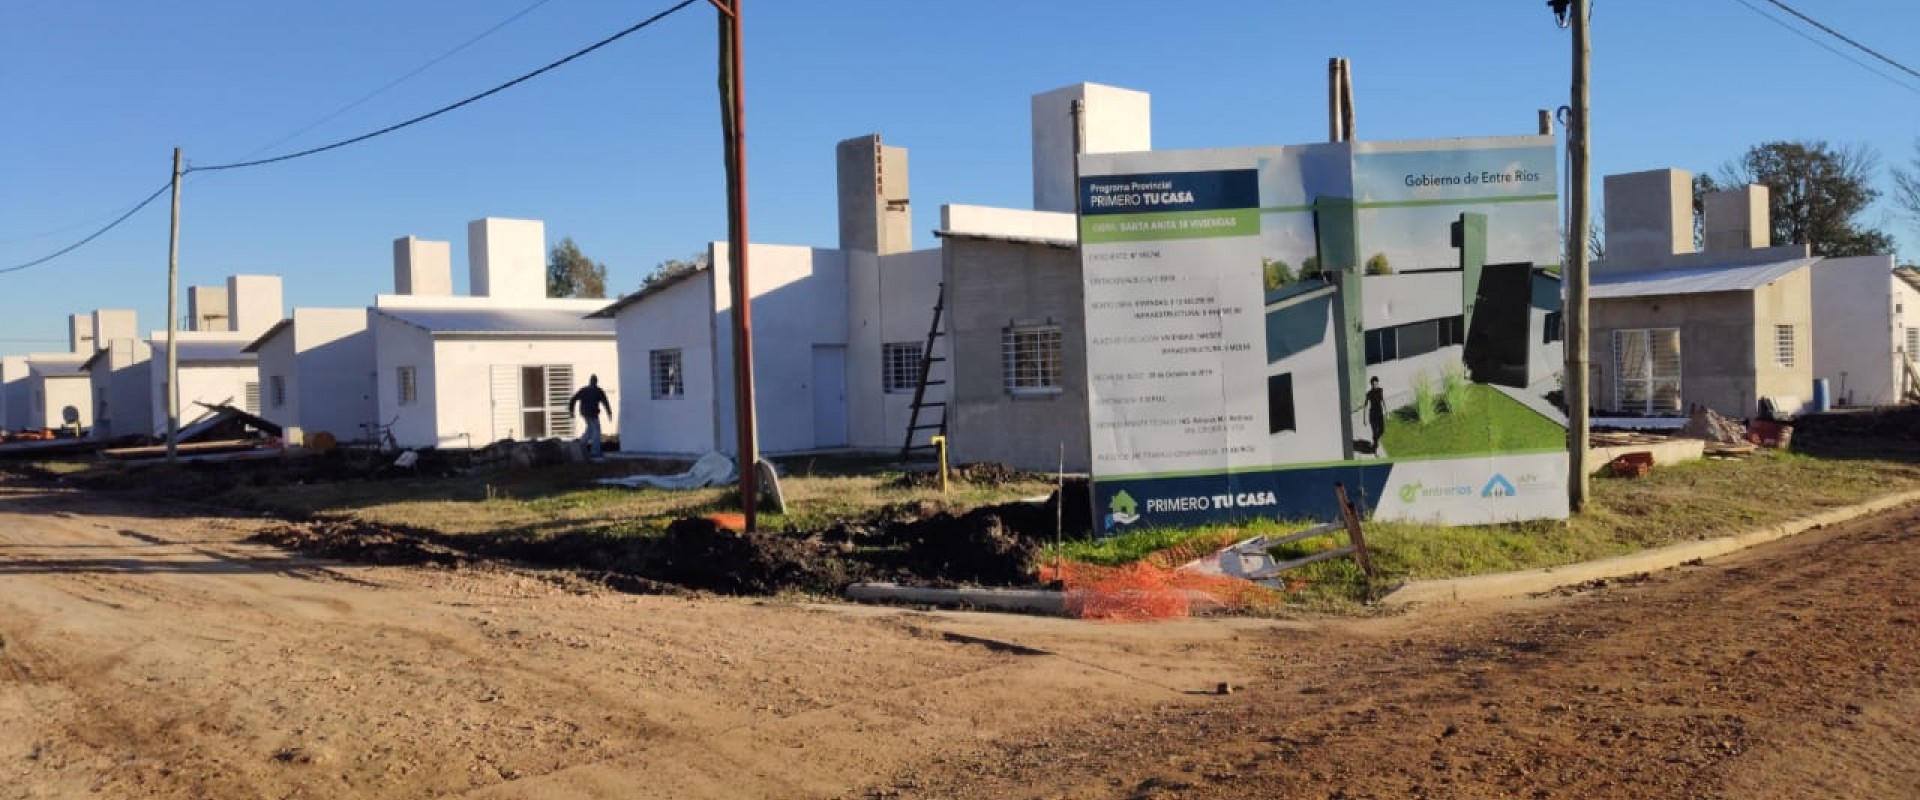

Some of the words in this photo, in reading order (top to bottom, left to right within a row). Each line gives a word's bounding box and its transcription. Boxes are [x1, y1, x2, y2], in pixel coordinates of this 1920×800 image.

[1090, 183, 1130, 194] Programa
[1132, 180, 1172, 191] Provincial
[1405, 174, 1460, 187] Gobierno
[1464, 172, 1478, 184] de
[1481, 171, 1511, 183] Entre
[1091, 194, 1141, 207] PRIMERO
[1143, 193, 1159, 205] TU
[1160, 191, 1194, 204] CASA
[1120, 222, 1149, 232] SANTA
[1151, 220, 1176, 231] ANITA
[1190, 217, 1237, 229] VIVIENDAS
[1147, 496, 1210, 512] PRIMERO
[1212, 493, 1233, 509] TU
[1236, 490, 1277, 507] CASA
